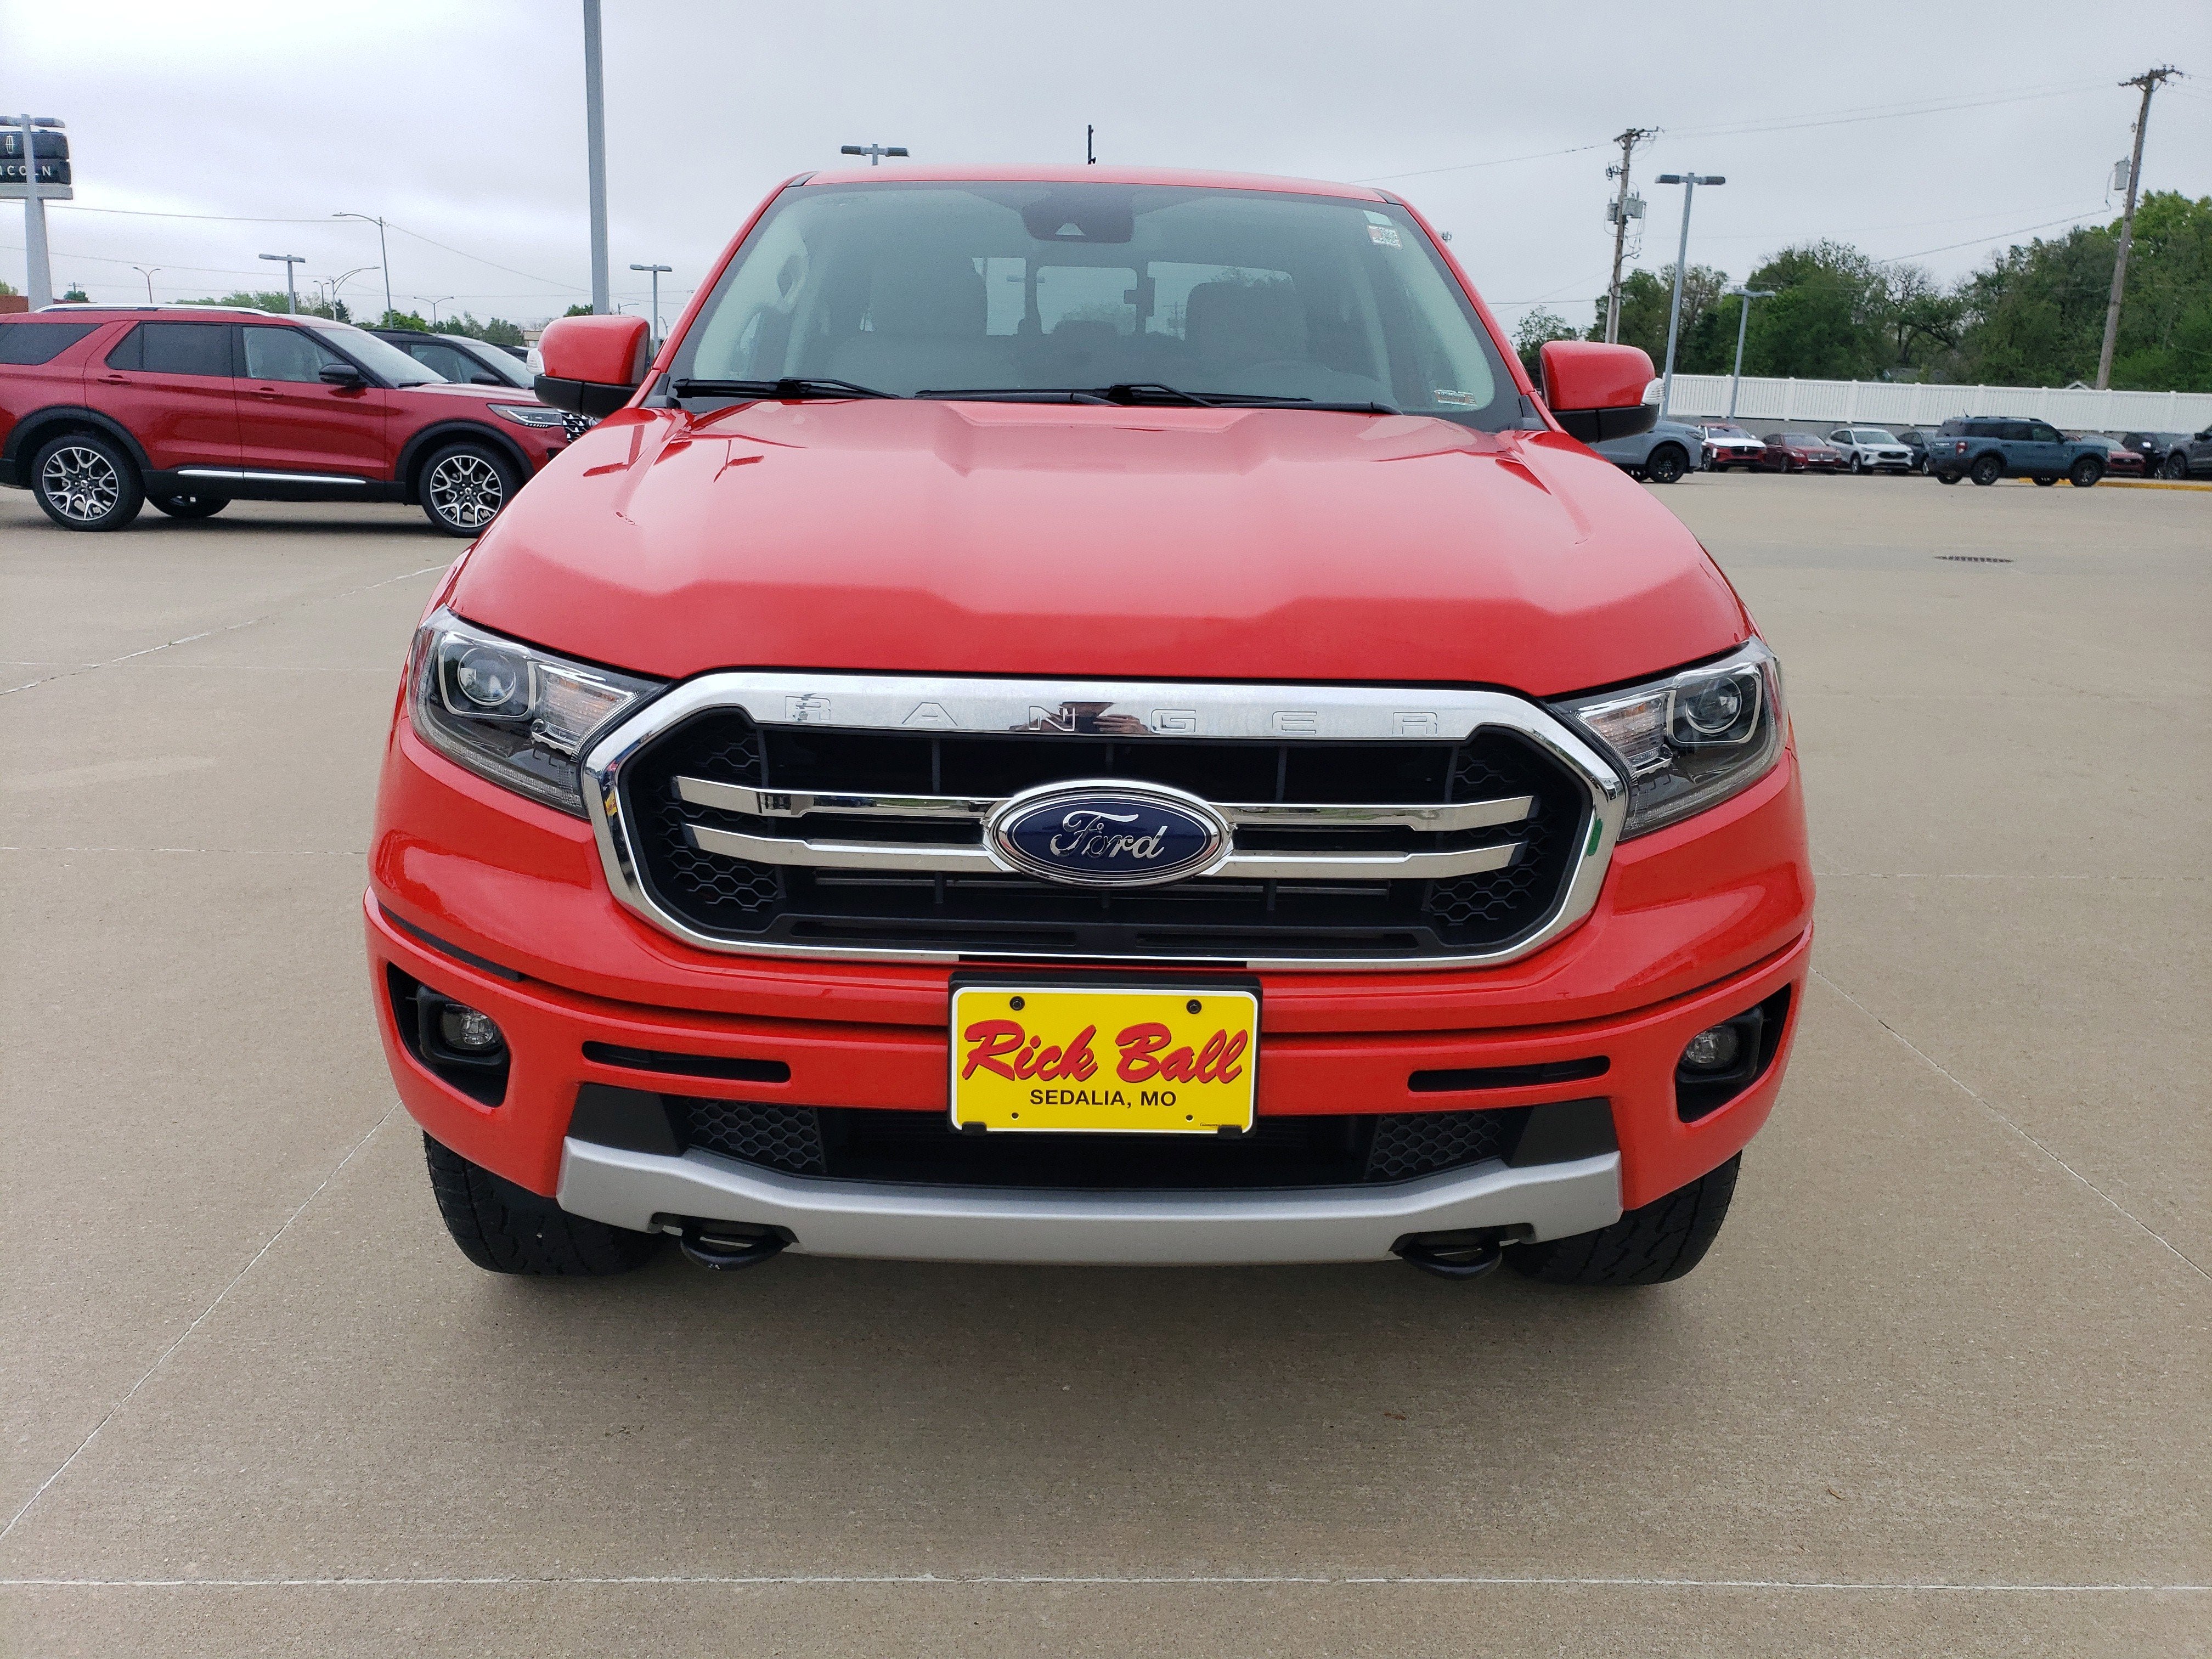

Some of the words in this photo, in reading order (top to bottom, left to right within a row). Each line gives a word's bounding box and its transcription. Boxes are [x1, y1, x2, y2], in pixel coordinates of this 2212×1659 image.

[786, 696, 1438, 735] RANGER
[1050, 810, 1168, 859] Ford
[962, 1019, 1099, 1082] Rick
[1115, 1022, 1248, 1085] Ball
[1030, 1089, 1132, 1109] SEDALIA,
[1141, 1090, 1177, 1107] MO
